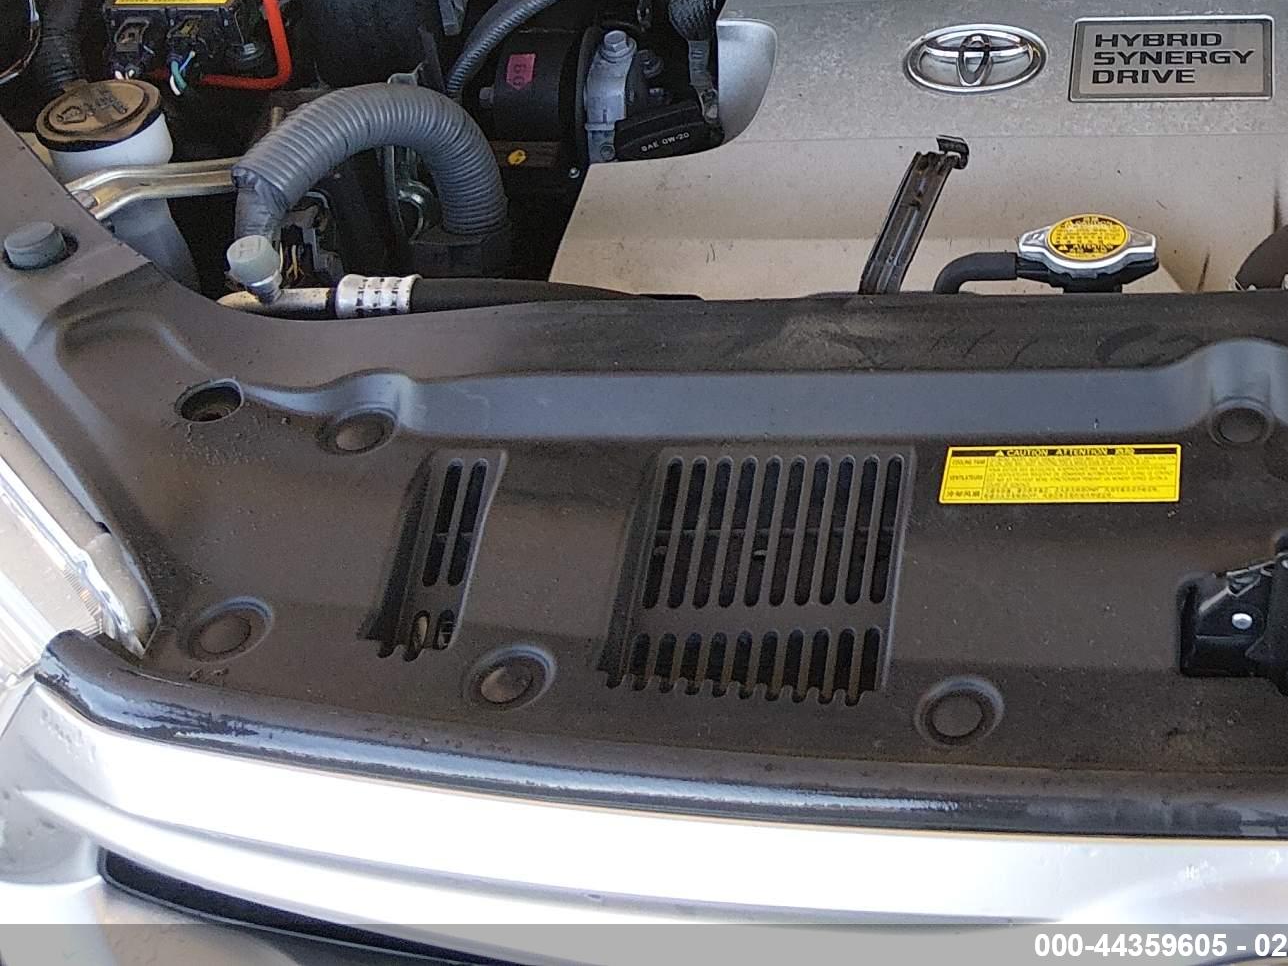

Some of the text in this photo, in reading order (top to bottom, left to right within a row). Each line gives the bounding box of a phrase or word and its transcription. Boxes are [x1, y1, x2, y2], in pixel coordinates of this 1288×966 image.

[1094, 33, 1223, 48] HYBRID
[1093, 50, 1255, 66] SYNERGY
[1091, 69, 1196, 84] DRIVE
[661, 131, 690, 145] 0W-20
[1006, 449, 1049, 457] CAUTION
[1056, 448, 1108, 456] ATTENTION
